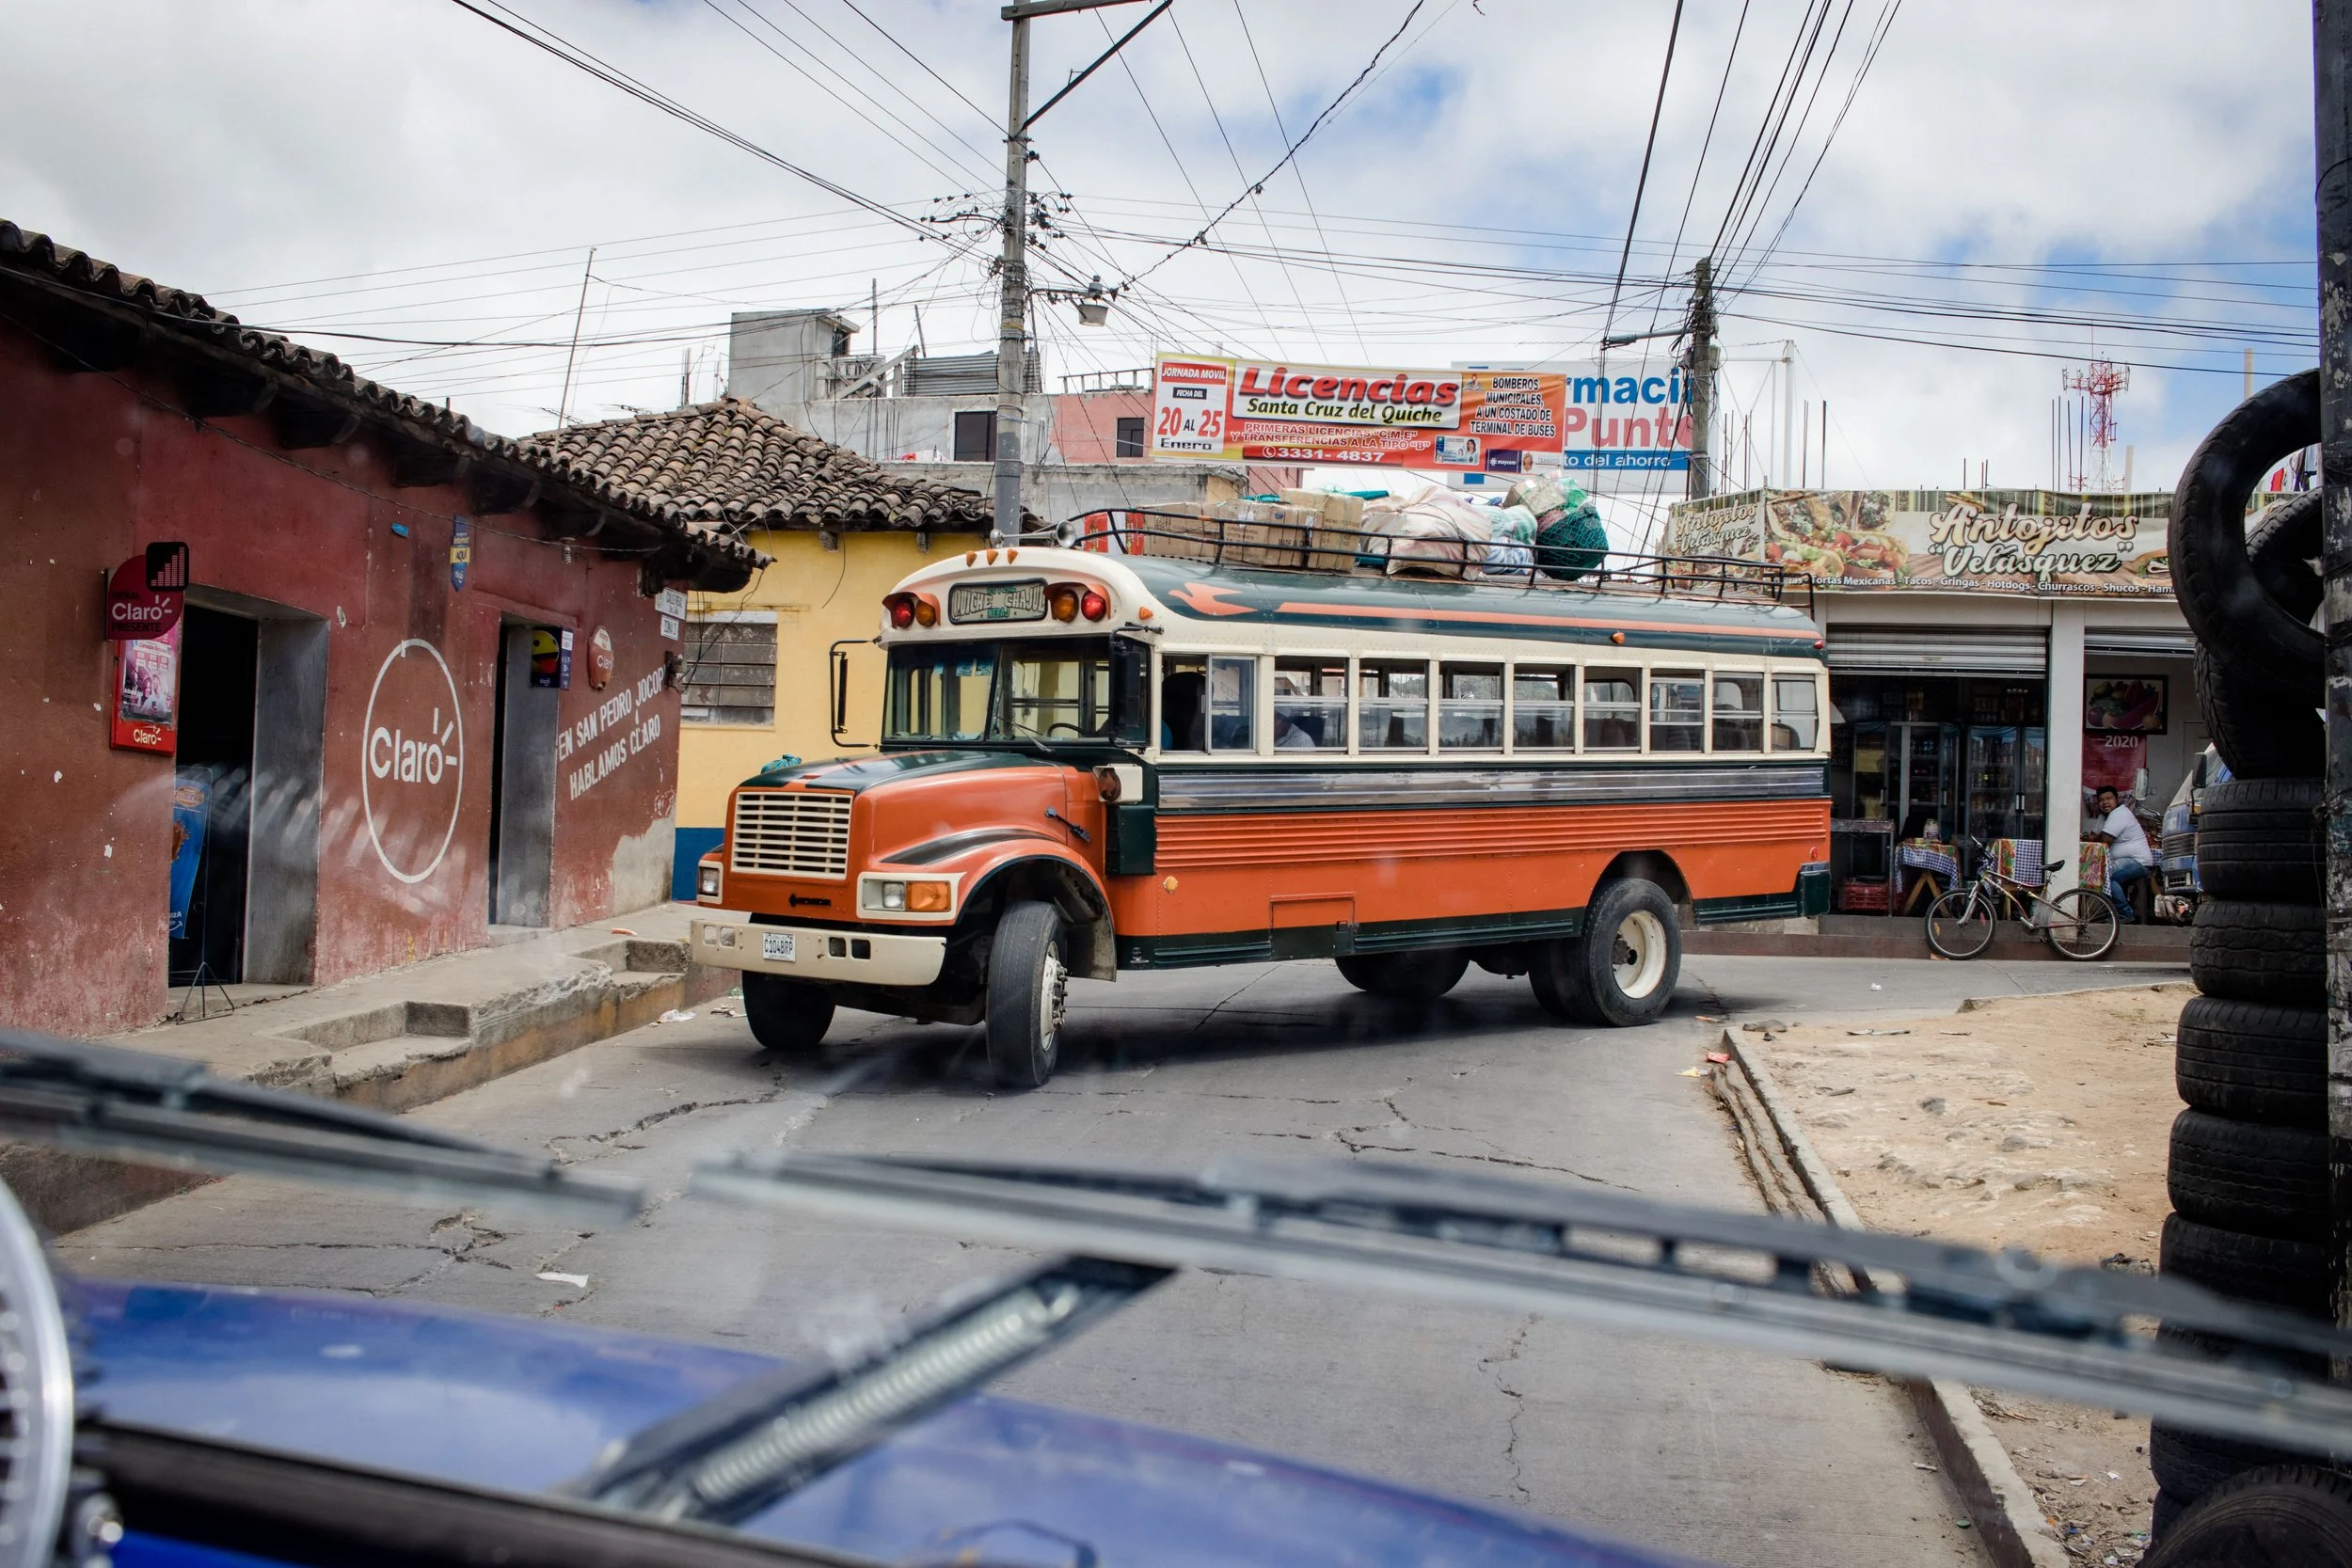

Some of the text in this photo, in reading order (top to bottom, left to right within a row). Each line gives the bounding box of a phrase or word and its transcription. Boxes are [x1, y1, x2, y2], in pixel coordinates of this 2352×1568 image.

[1162, 367, 1226, 380] JORNADA MOVIL
[1239, 366, 1459, 406] Licencias
[1492, 377, 1539, 390] BOMBEROS
[1566, 366, 1692, 404] maci
[1485, 391, 1544, 406] MUNICIPALES,
[1248, 398, 1442, 424] Santa Cruz del Quiche
[1476, 406, 1551, 421] A UN COSTADO DE
[1157, 406, 1223, 437] 20 AL 25
[1245, 422, 1306, 435] PRIMERAS
[1308, 426, 1371, 438] LICENCIAS
[1470, 420, 1555, 437] TERMINAL DE BUSES
[1160, 437, 1212, 451] Enero
[1230, 432, 1239, 442] Y
[1243, 433, 1348, 447] TRANSFERENCIAS
[1350, 438, 1359, 448] A
[1361, 438, 1377, 449] LA
[1379, 439, 1407, 450] TIPO
[1336, 450, 1385, 463] 4837
[1584, 453, 1610, 467] del
[1614, 453, 1672, 467] ahorro
[1677, 499, 1757, 536] Antojitos
[1930, 502, 2139, 554] Antojitos
[1811, 576, 1842, 586] Tortas
[1843, 577, 1897, 586] Mexicanas
[1904, 577, 1932, 586] Tacos
[1940, 577, 1979, 589] Gringas
[1987, 578, 2030, 592] Hotdogs
[2038, 580, 2095, 593] Churrascos
[2103, 583, 2140, 594] Shucos
[2148, 583, 2175, 594] Ham
[112, 601, 164, 621] Claro
[112, 622, 163, 633] PRESENTE
[559, 664, 667, 761] EN SAN PEDRO JOCOP
[133, 728, 158, 746] Claro
[2105, 735, 2139, 748] 2020
[370, 723, 444, 784] Claro
[569, 714, 660, 800] HABLAMOS CLARO
